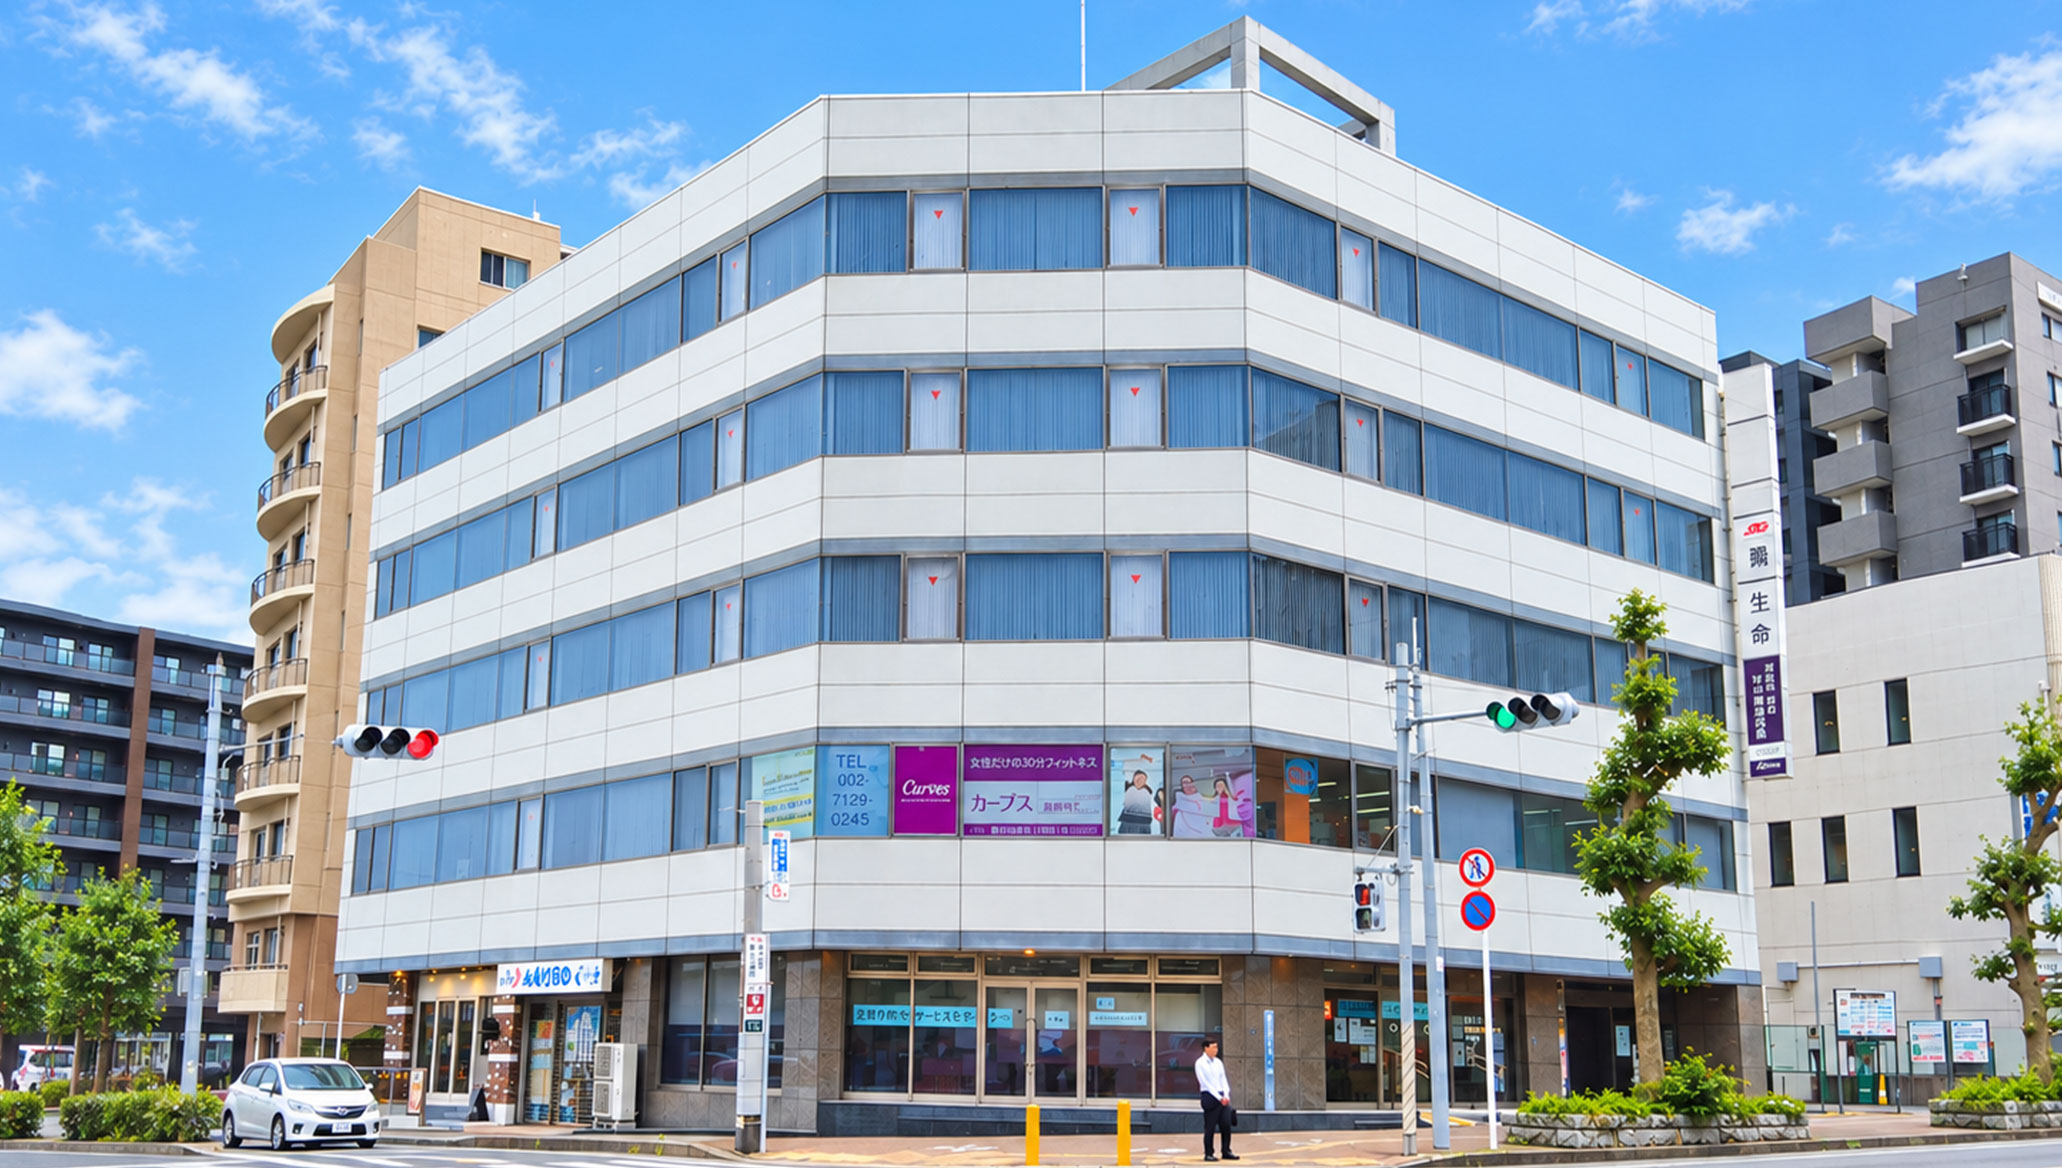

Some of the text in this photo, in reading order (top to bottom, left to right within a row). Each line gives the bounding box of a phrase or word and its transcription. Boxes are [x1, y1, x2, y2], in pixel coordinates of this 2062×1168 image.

[836, 754, 867, 769] TEL
[902, 779, 951, 796] Curves
[971, 793, 1033, 813] カーブス
[830, 812, 870, 827] 0245
